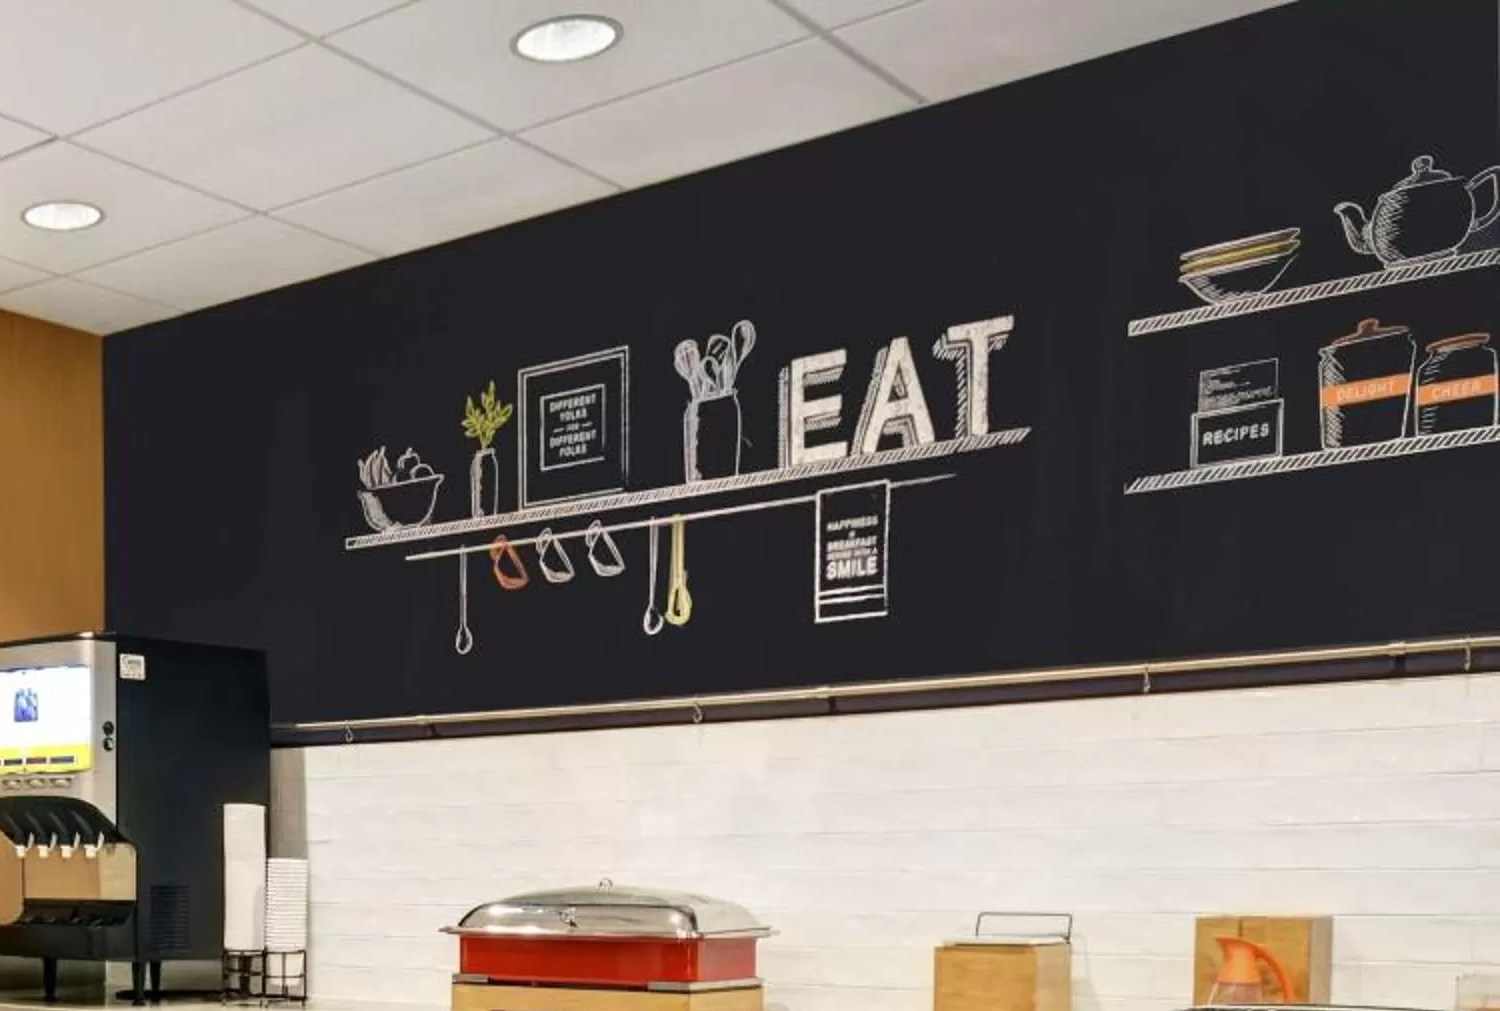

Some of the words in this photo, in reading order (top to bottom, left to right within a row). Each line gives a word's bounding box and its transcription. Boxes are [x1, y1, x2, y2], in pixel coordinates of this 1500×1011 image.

[779, 315, 1015, 468] EAT
[1431, 380, 1481, 398] CHEER
[1202, 422, 1270, 446] RECIPES
[826, 555, 879, 580] SMILE
